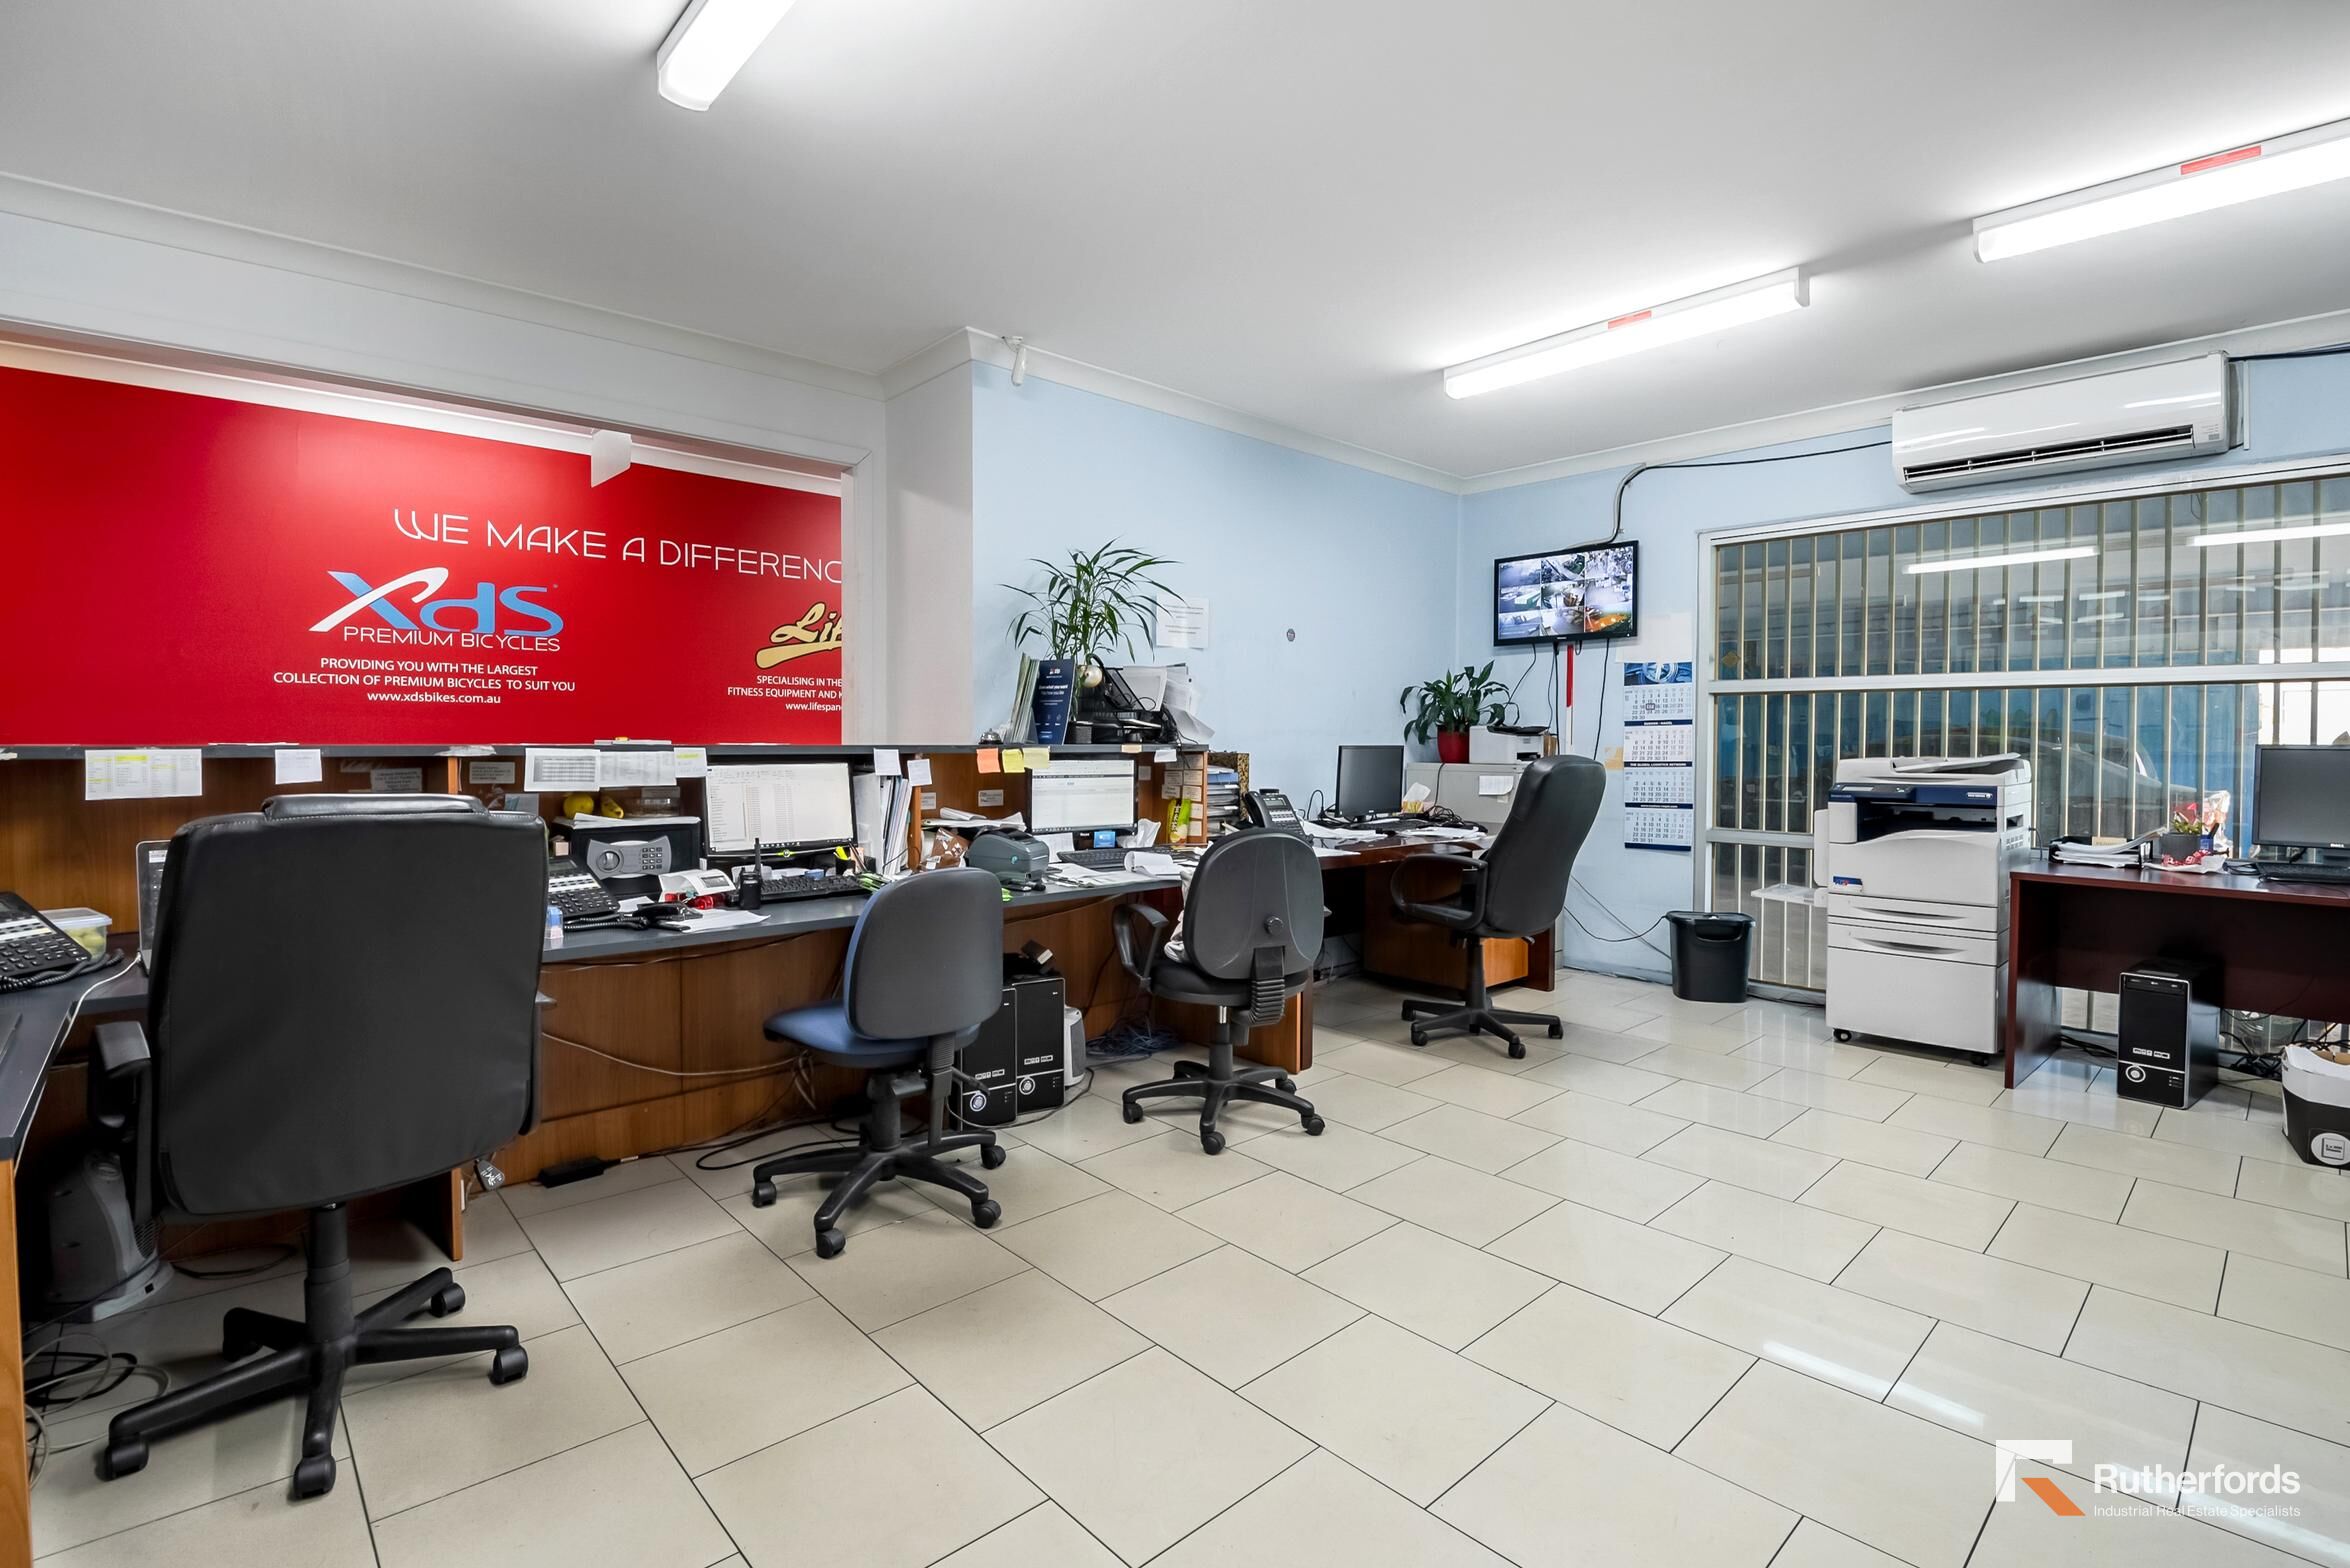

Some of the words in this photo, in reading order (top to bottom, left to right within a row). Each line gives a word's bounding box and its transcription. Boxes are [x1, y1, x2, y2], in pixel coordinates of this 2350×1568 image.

[394, 508, 469, 545] WE
[487, 519, 607, 559] MAKE
[622, 537, 645, 563] A
[343, 626, 453, 647] PREMIUM
[461, 632, 561, 652] BICYCLES
[320, 657, 395, 671] PROVIDING
[397, 661, 424, 672] YOU
[427, 662, 459, 673] WITH
[461, 663, 484, 674] THE
[487, 665, 538, 676] LARGEST
[273, 672, 360, 685] COLLECTION
[363, 674, 381, 685] OF
[384, 676, 444, 688] PREMIUM
[447, 677, 502, 689] BICYCLES
[506, 679, 523, 689] TO
[525, 680, 550, 691] SUIT
[552, 681, 576, 691] YOU
[756, 675, 815, 686] SPECIALISING
[816, 678, 825, 687] IN
[826, 678, 842, 688] THE
[367, 691, 501, 704] www.xdsbikes.com.au
[727, 686, 764, 697] FITNESS
[765, 687, 816, 698] EQUIPMENT
[818, 690, 838, 699] AND
[785, 702, 842, 712] www.lifespan
